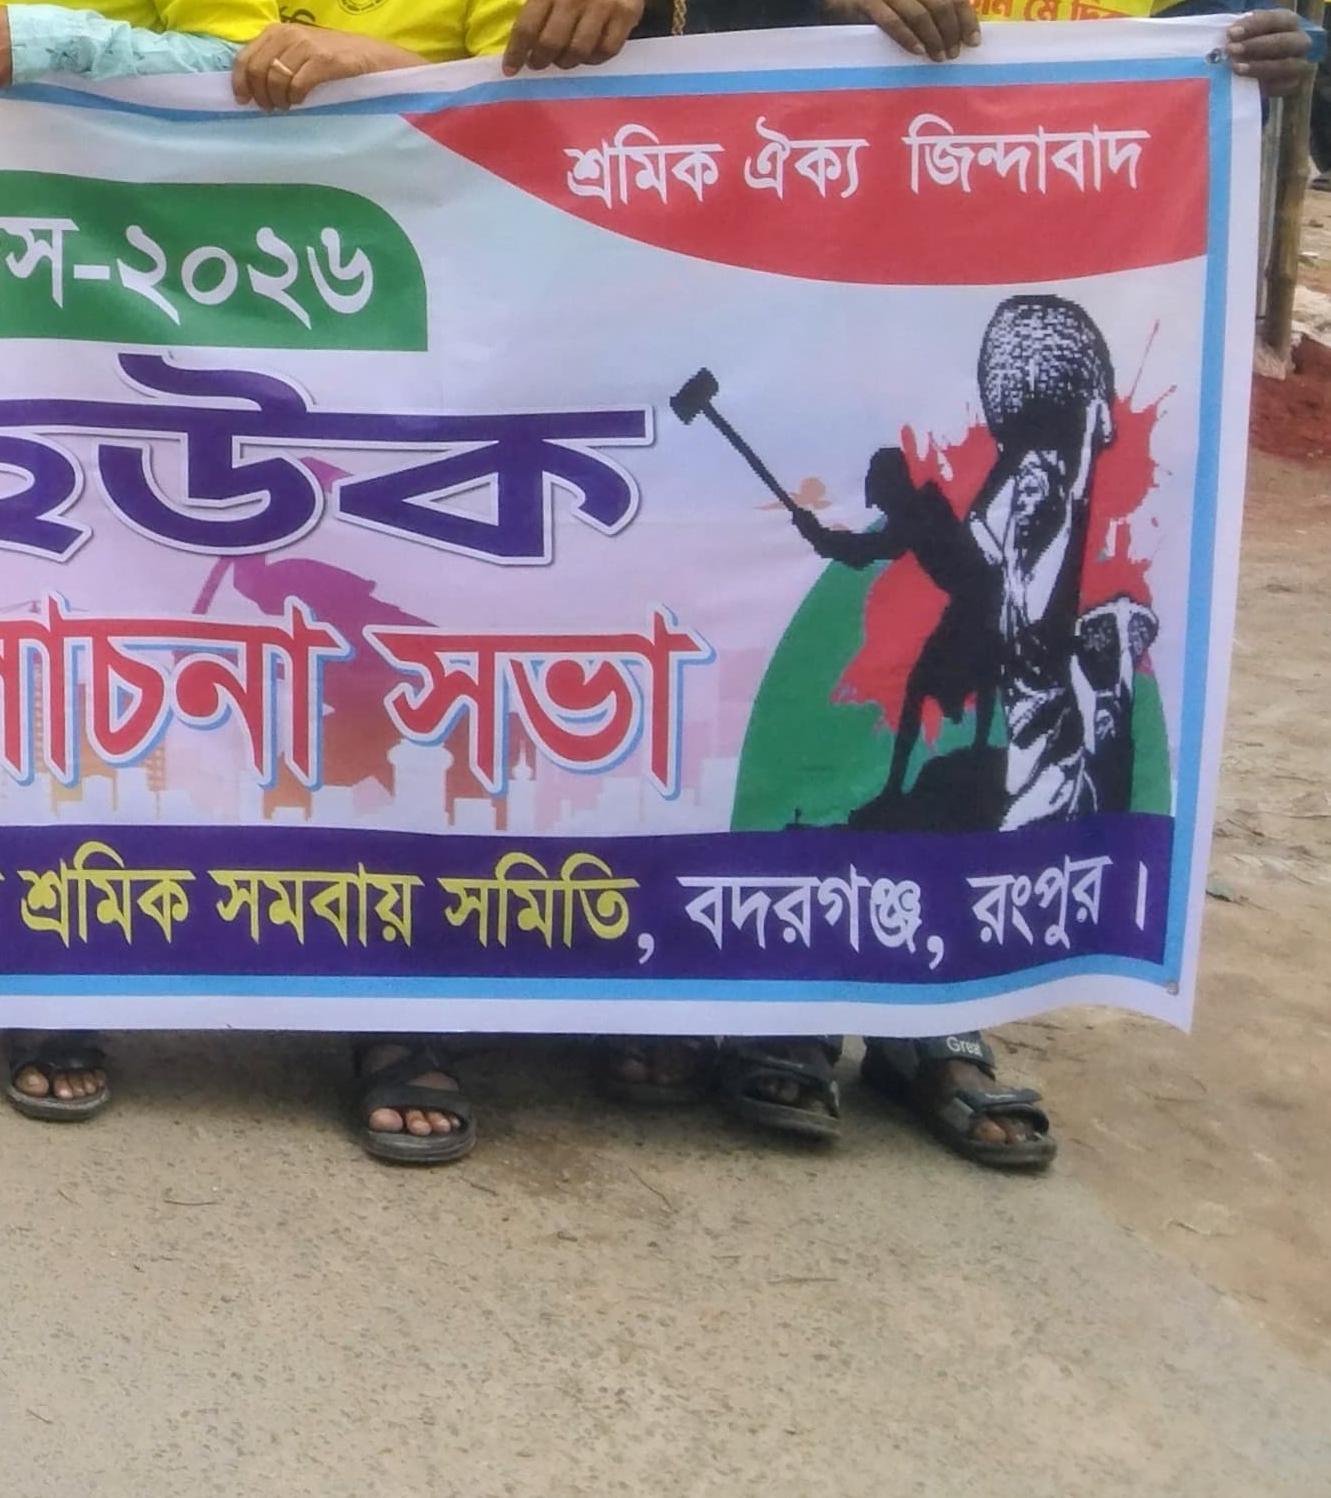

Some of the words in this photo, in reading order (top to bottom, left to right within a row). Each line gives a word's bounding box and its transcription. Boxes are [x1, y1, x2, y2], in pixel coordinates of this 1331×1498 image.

[564, 123, 724, 209] শ্রমিক
[743, 116, 868, 199] ঐক্য
[903, 112, 1151, 195] জিন্দাবাদ
[363, 605, 715, 800] সভা
[17, 840, 195, 948] শ্রমিক
[209, 863, 423, 948] সমবায়
[439, 851, 655, 965] সমিতি,
[678, 863, 945, 970] বদরগঞ্জ,
[968, 855, 1111, 948] রংপুর
